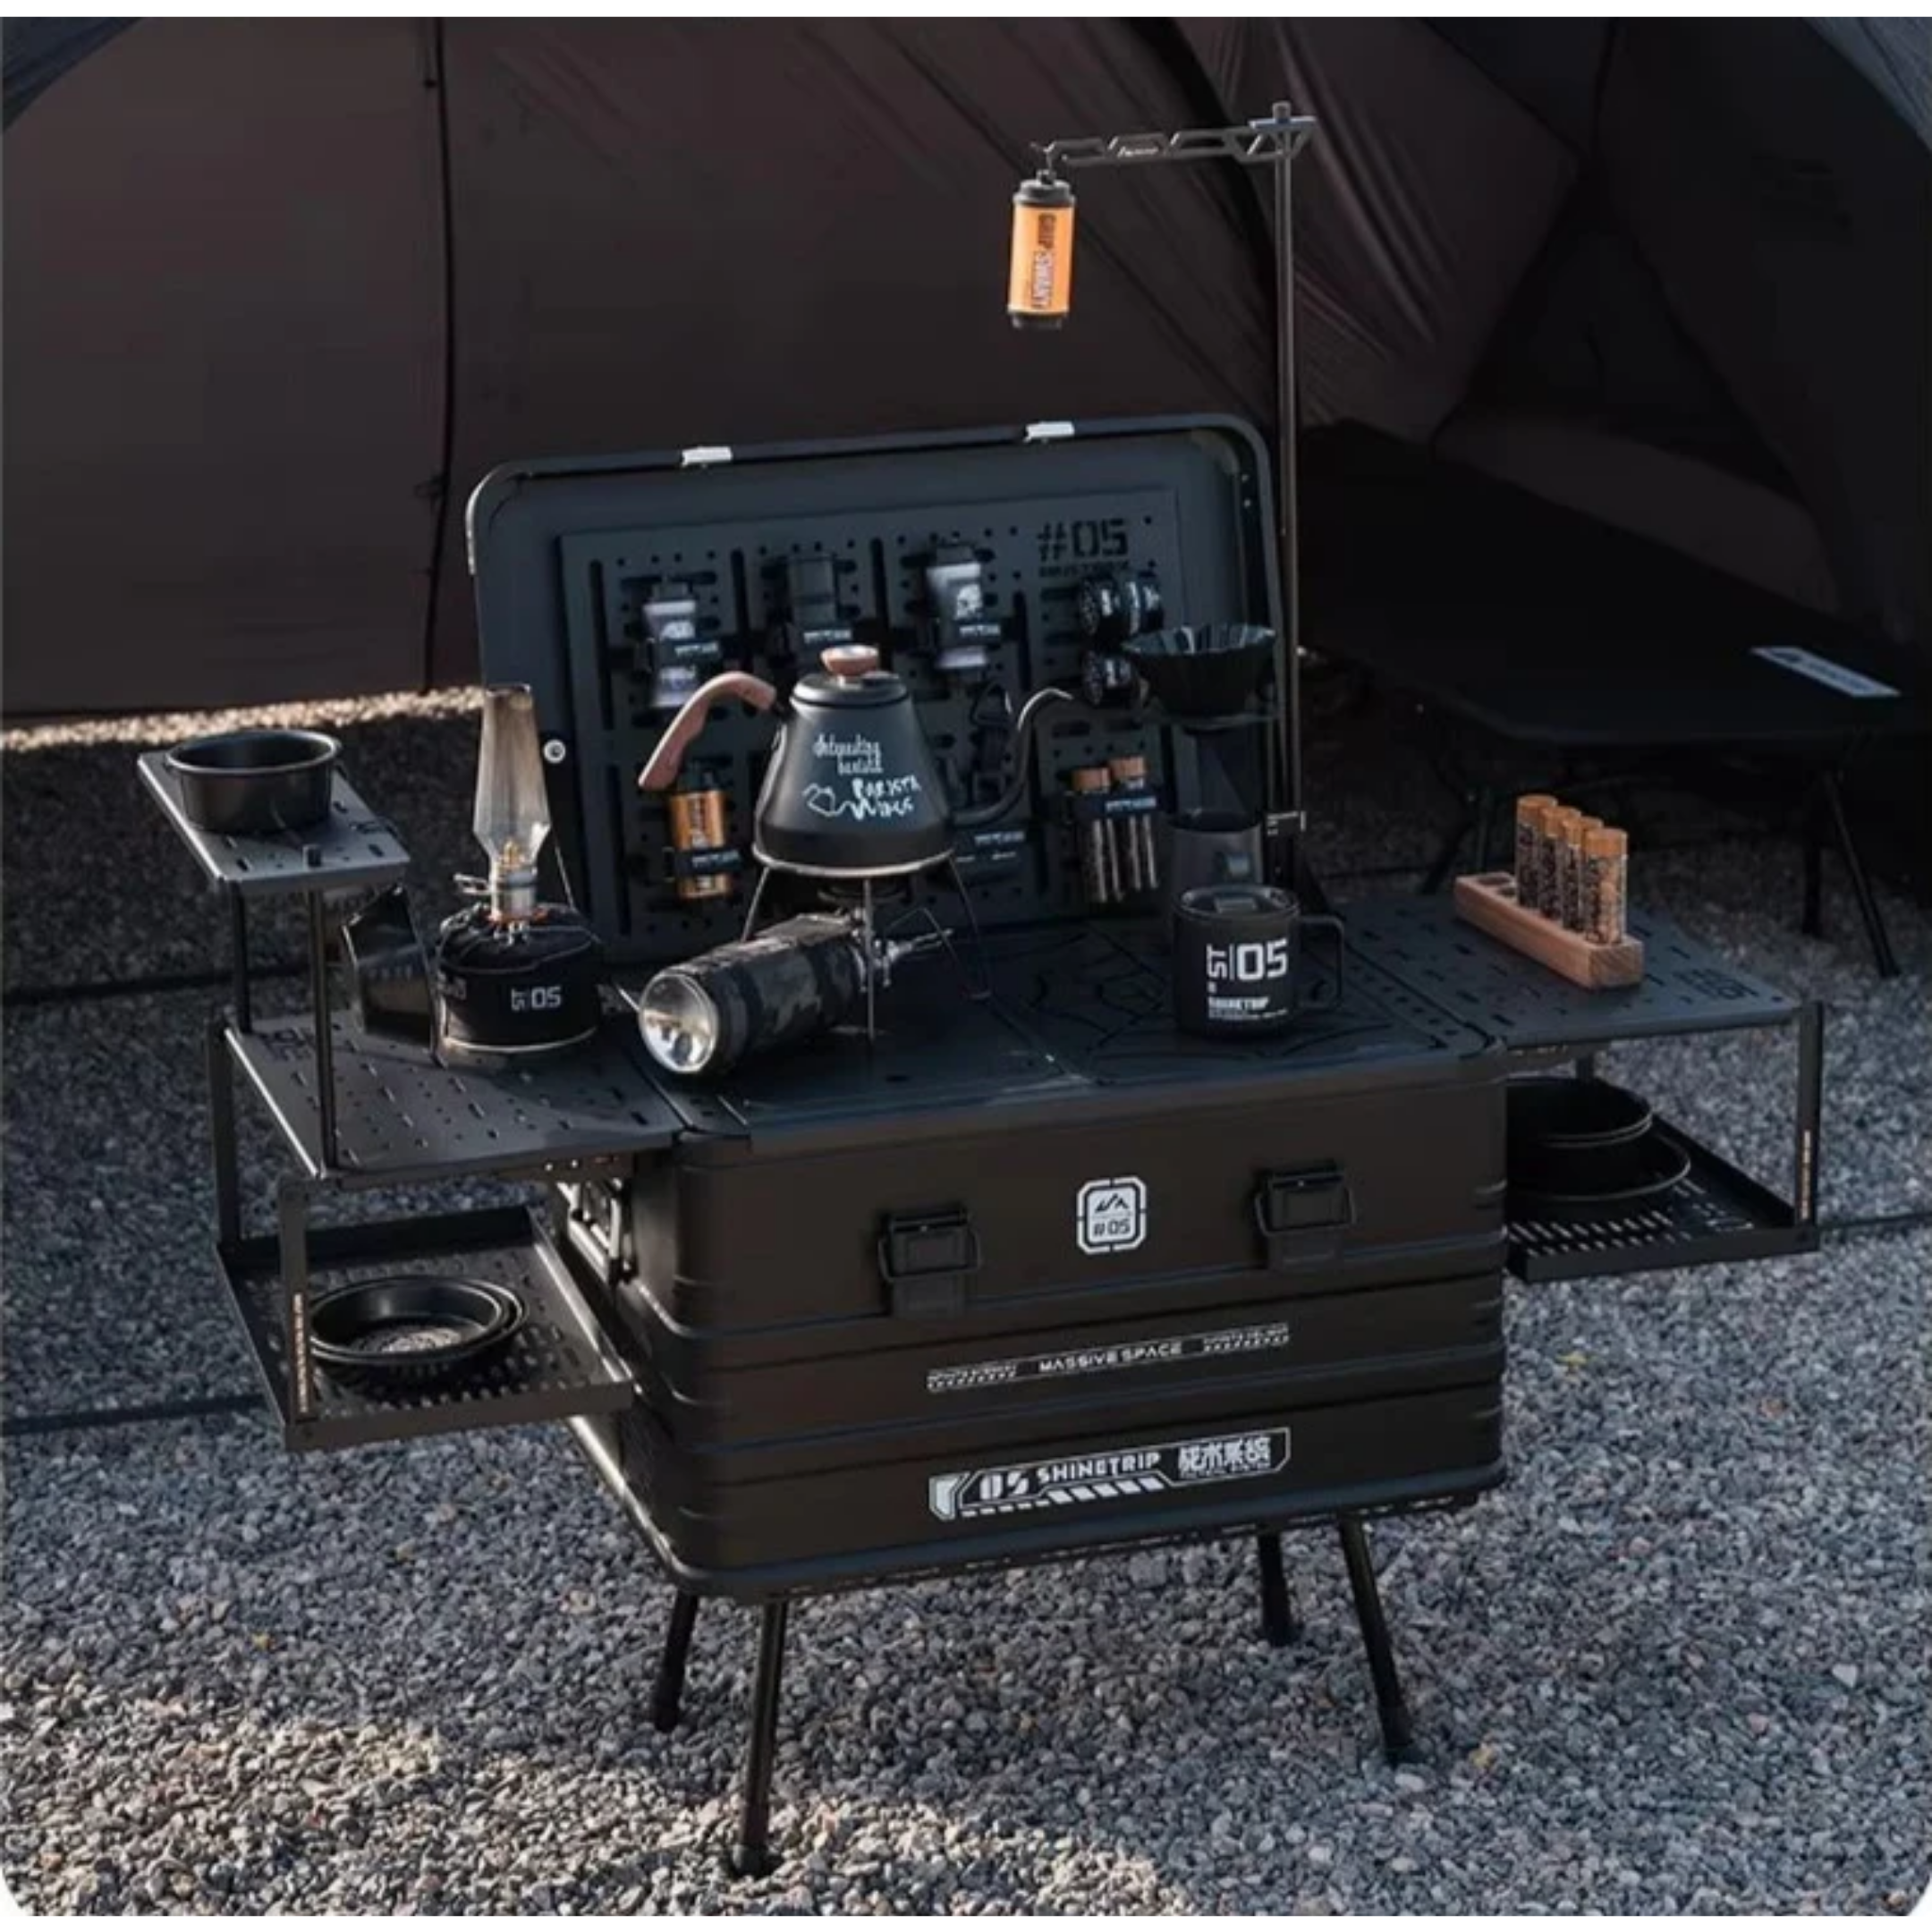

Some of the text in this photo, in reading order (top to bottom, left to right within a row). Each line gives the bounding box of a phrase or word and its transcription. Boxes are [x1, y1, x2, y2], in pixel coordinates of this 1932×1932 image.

[1037, 518, 1129, 562] #05
[1236, 937, 1288, 982] 05
[530, 985, 563, 1010] 05
[1038, 1342, 1183, 1374] MASSIVE SPACE
[1036, 1451, 1162, 1484] SHINETRIP
